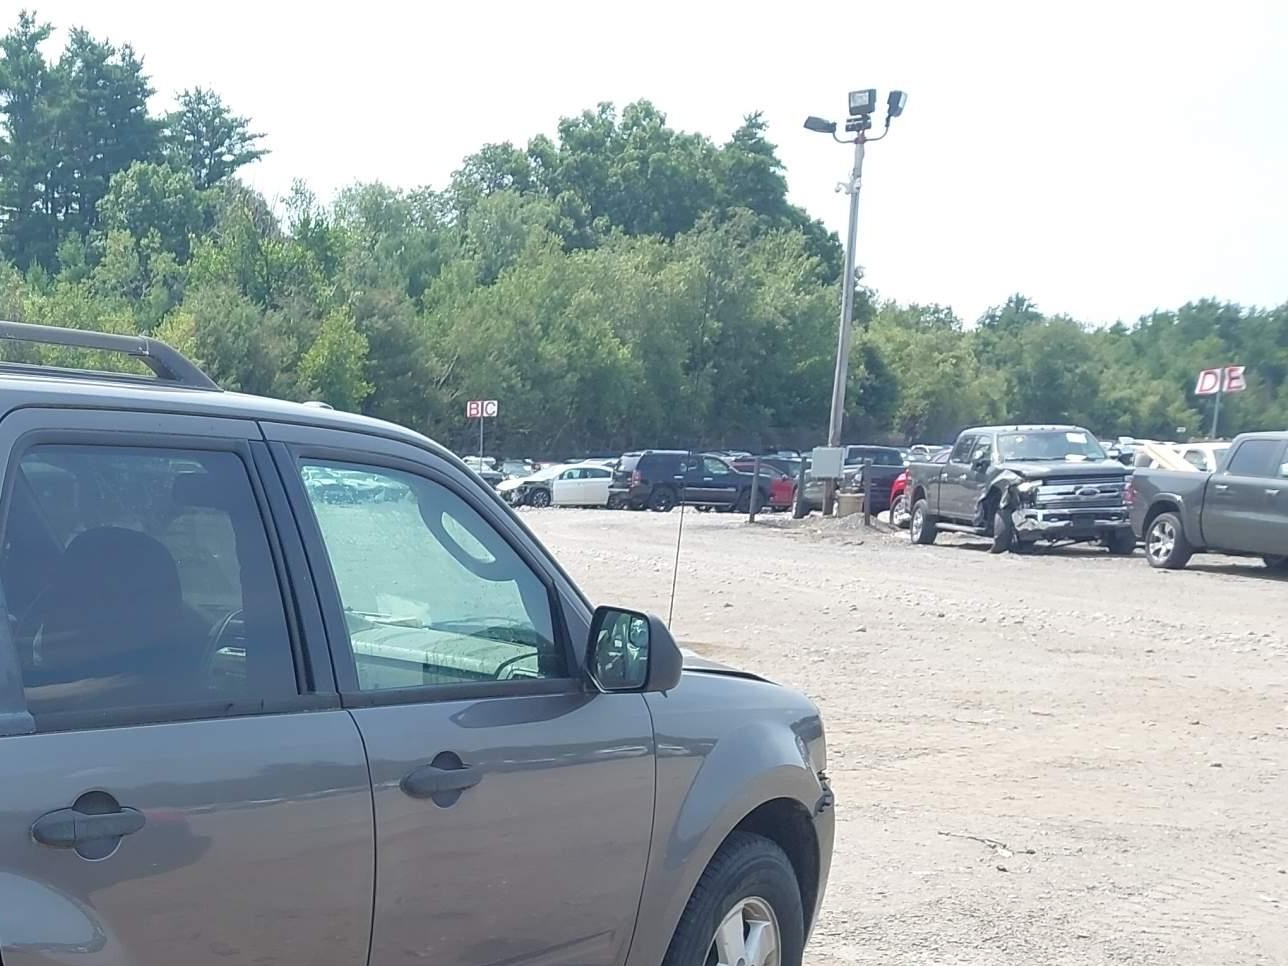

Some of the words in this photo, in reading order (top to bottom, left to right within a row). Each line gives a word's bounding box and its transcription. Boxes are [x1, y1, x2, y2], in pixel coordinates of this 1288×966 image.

[1198, 370, 1219, 393] D
[1227, 367, 1243, 390] E
[469, 401, 480, 416] B
[485, 401, 496, 416] C
